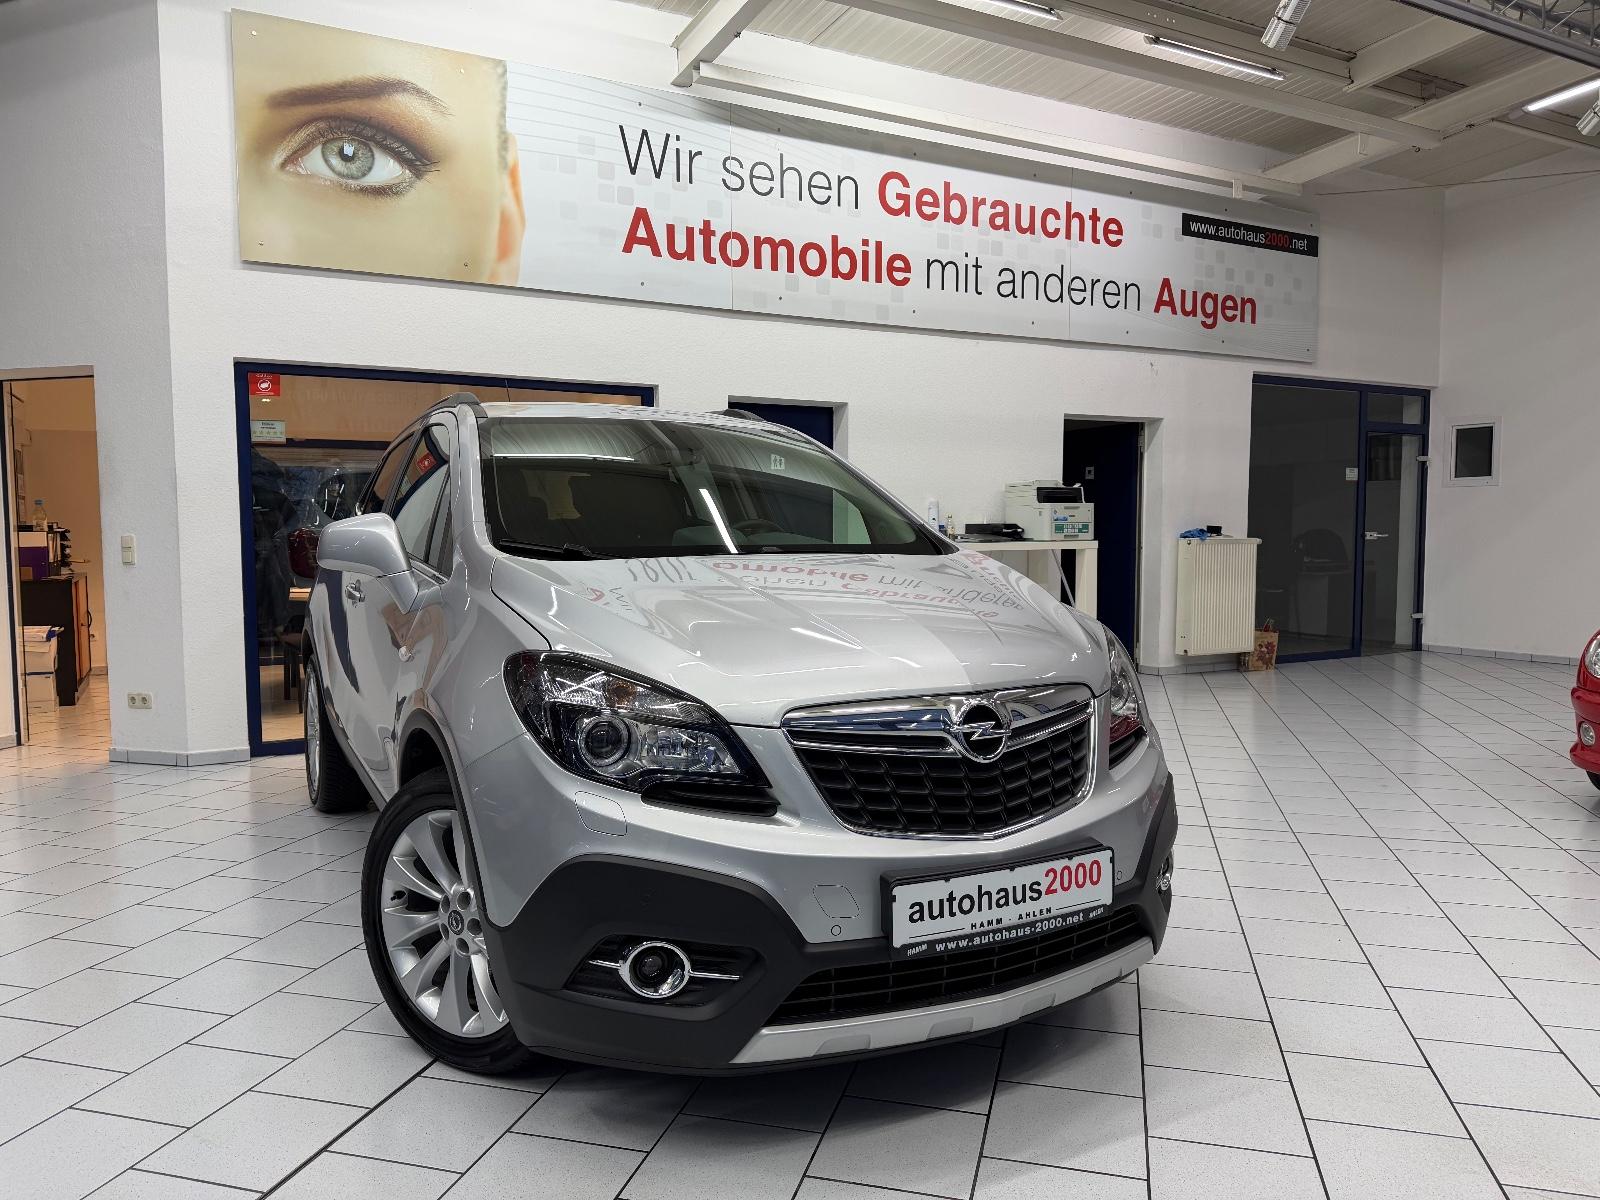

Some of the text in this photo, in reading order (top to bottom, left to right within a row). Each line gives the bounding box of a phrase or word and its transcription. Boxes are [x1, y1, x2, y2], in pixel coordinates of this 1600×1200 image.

[619, 124, 1124, 248] Wir sehen Gebrauchte
[1189, 220, 1308, 251] www.autohaus2000.net
[621, 207, 1258, 330] Automobile mit anderen Augen
[908, 859, 1102, 924] autohaus2000
[935, 913, 1084, 952] www.autohaus-2000.net
[971, 917, 1004, 931] HAMM
[1018, 906, 1053, 921] AHLEN
